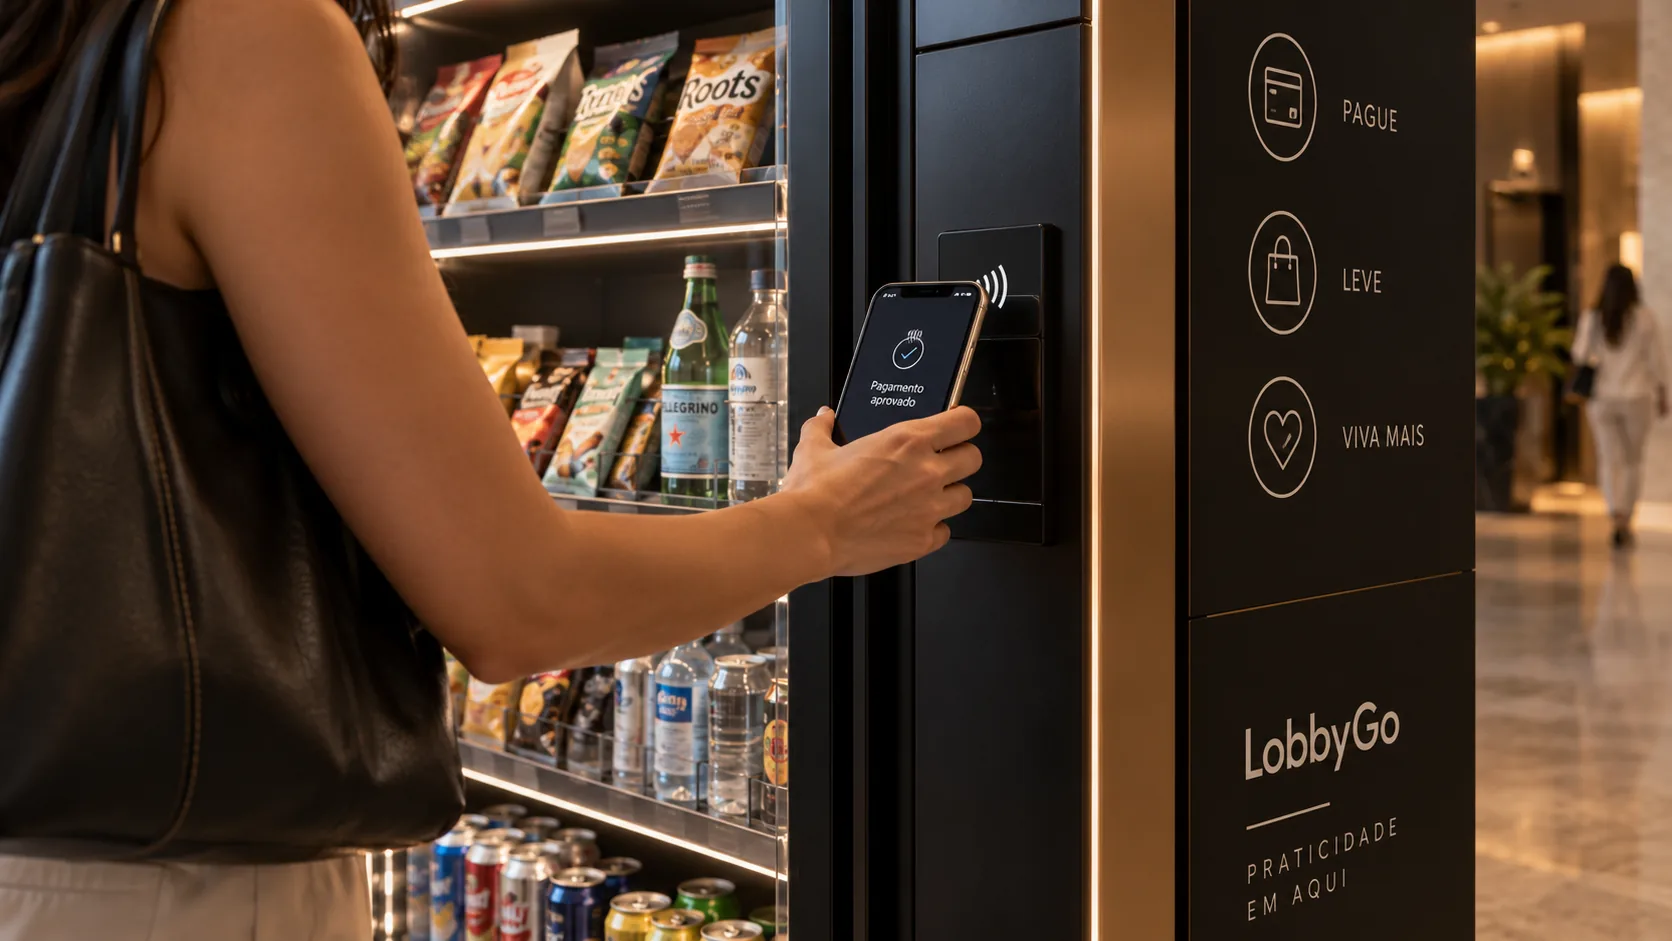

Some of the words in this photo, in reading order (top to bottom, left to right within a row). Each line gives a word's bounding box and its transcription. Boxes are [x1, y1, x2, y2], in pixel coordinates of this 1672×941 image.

[679, 70, 760, 110] Roots
[1343, 99, 1398, 133] PAGUE
[1343, 268, 1382, 294] LEVE
[870, 380, 924, 394] Pagamento
[870, 396, 916, 408] aprovado
[1342, 425, 1380, 449] VIVA
[1386, 423, 1425, 447] MAIS
[1245, 701, 1400, 781] LobbyGo
[1247, 816, 1397, 885] PRATICIDADE
[1247, 892, 1277, 922] EM
[1291, 868, 1346, 906] AQUI
